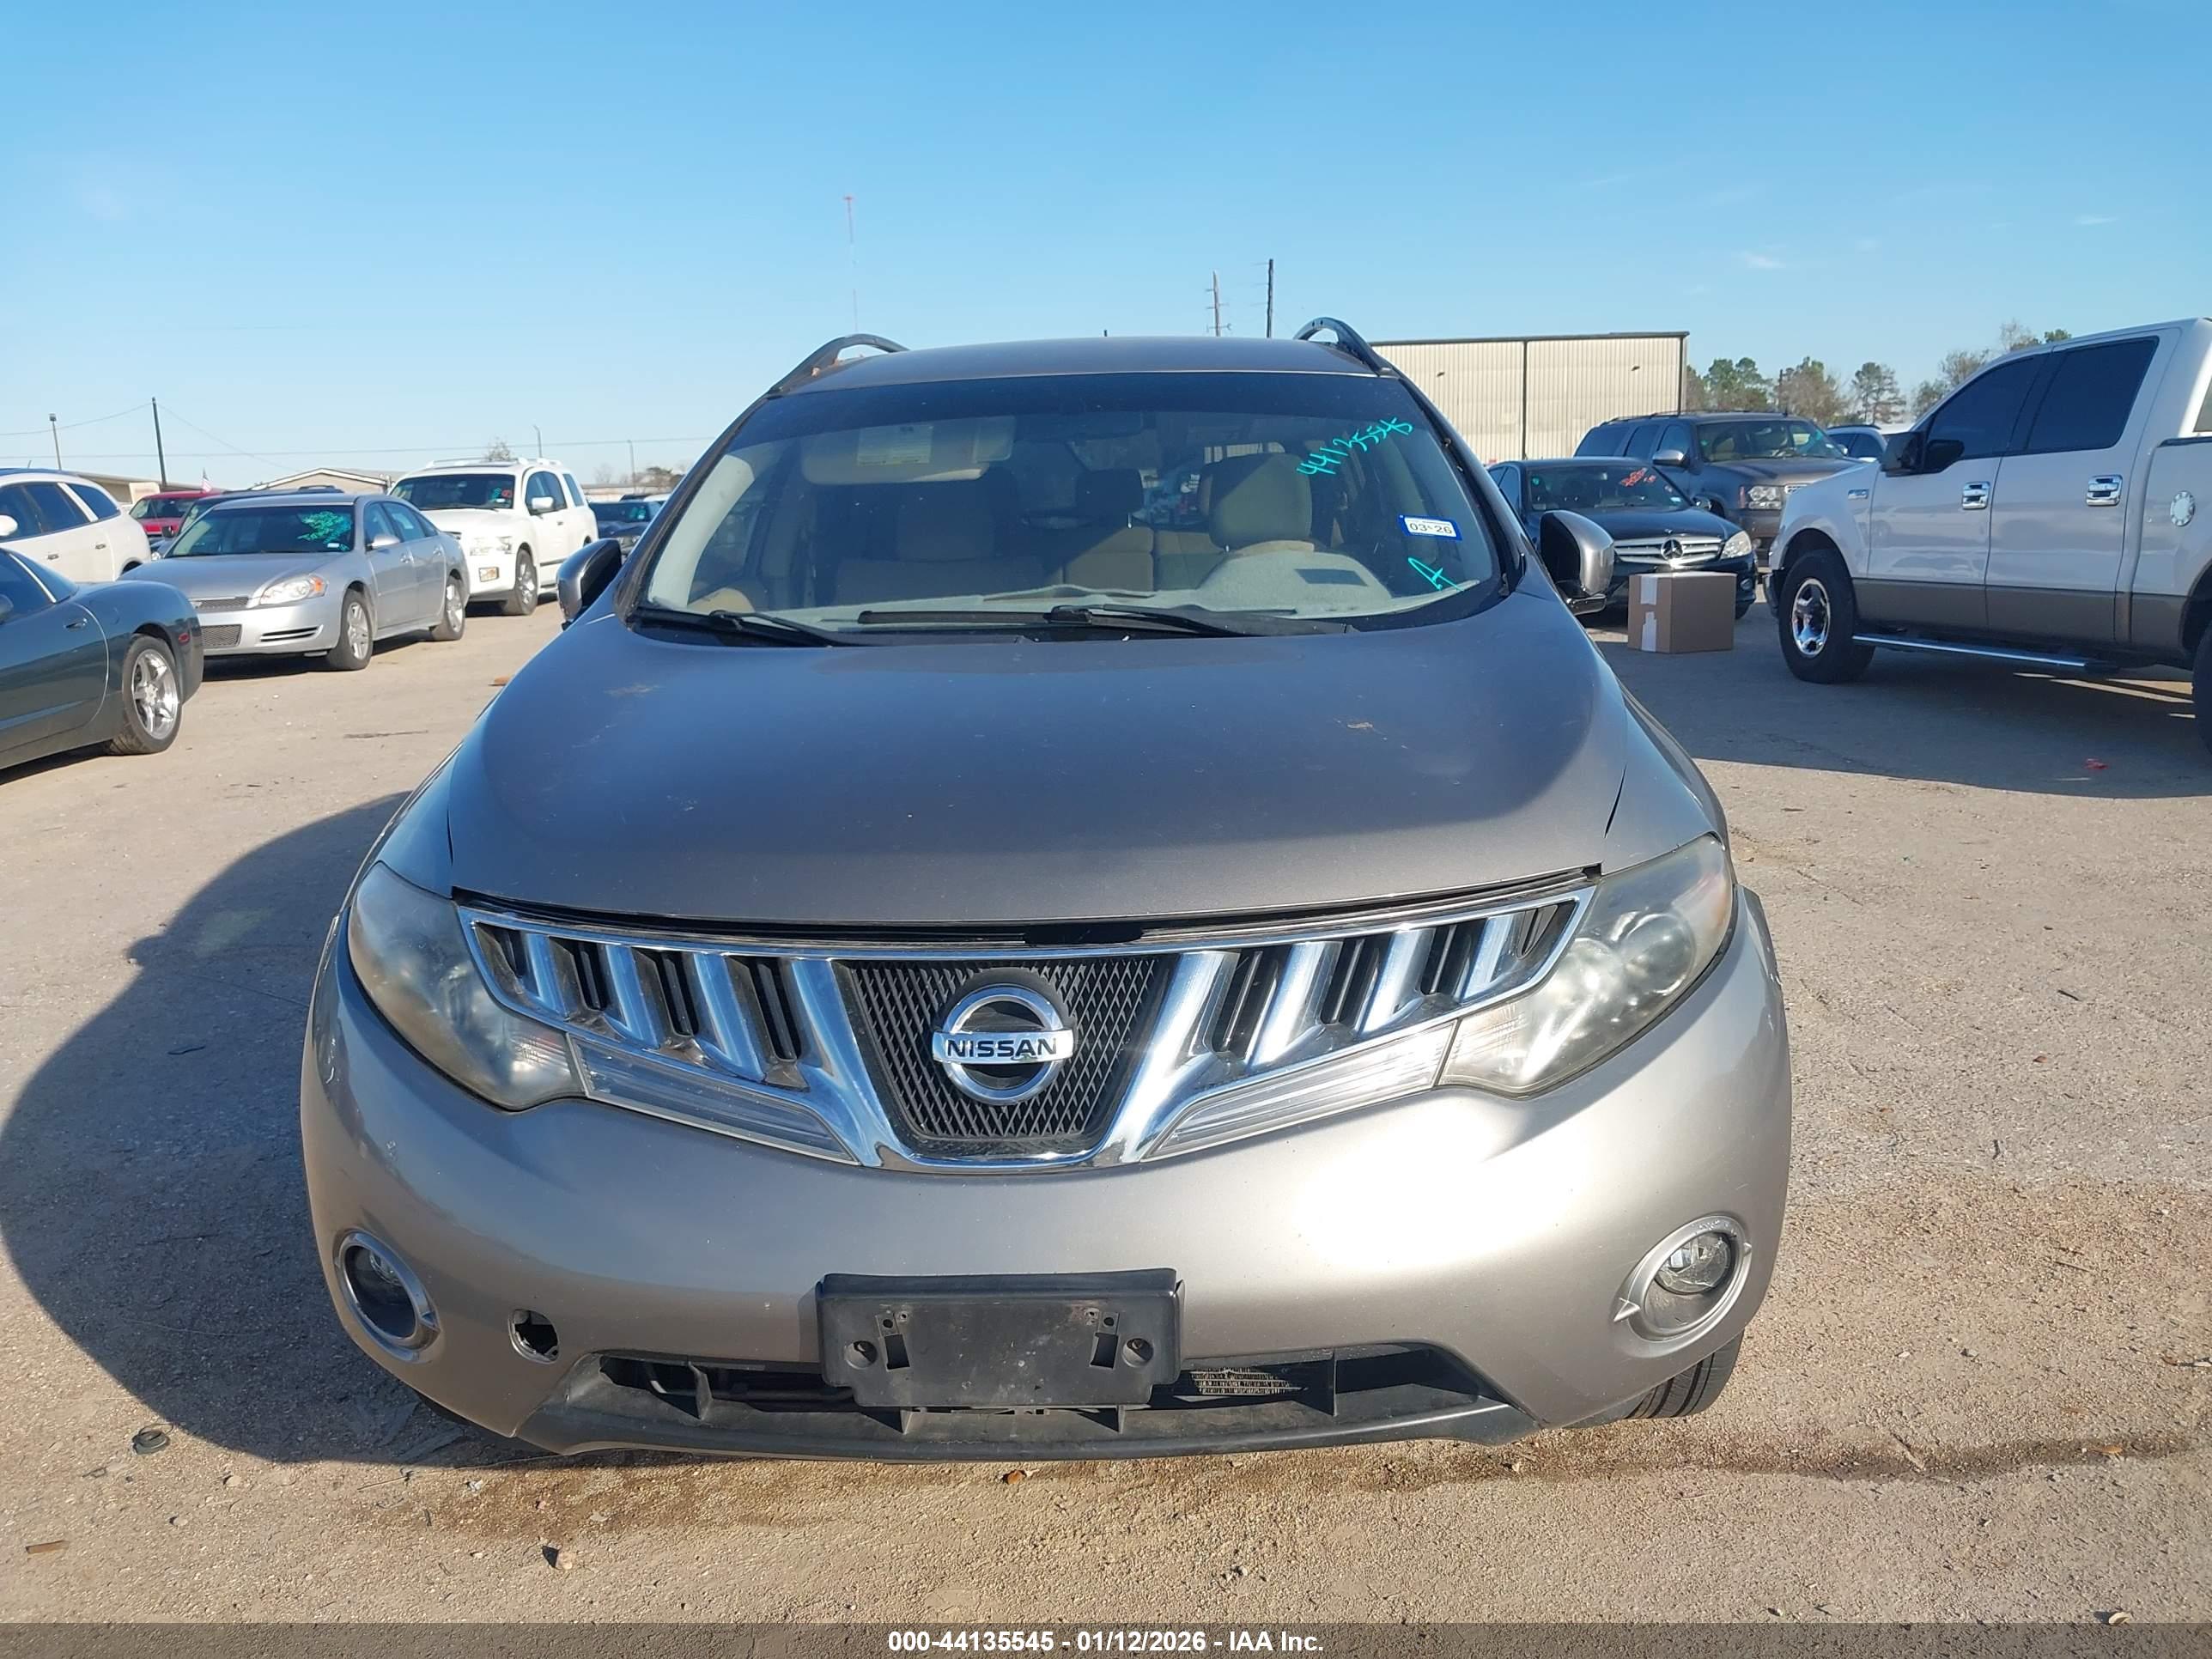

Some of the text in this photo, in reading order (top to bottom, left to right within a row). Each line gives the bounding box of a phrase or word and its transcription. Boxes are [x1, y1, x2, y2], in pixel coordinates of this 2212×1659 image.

[1409, 522, 1428, 532] 03
[1434, 525, 1453, 534] 26
[947, 1037, 1057, 1058] NISSAN
